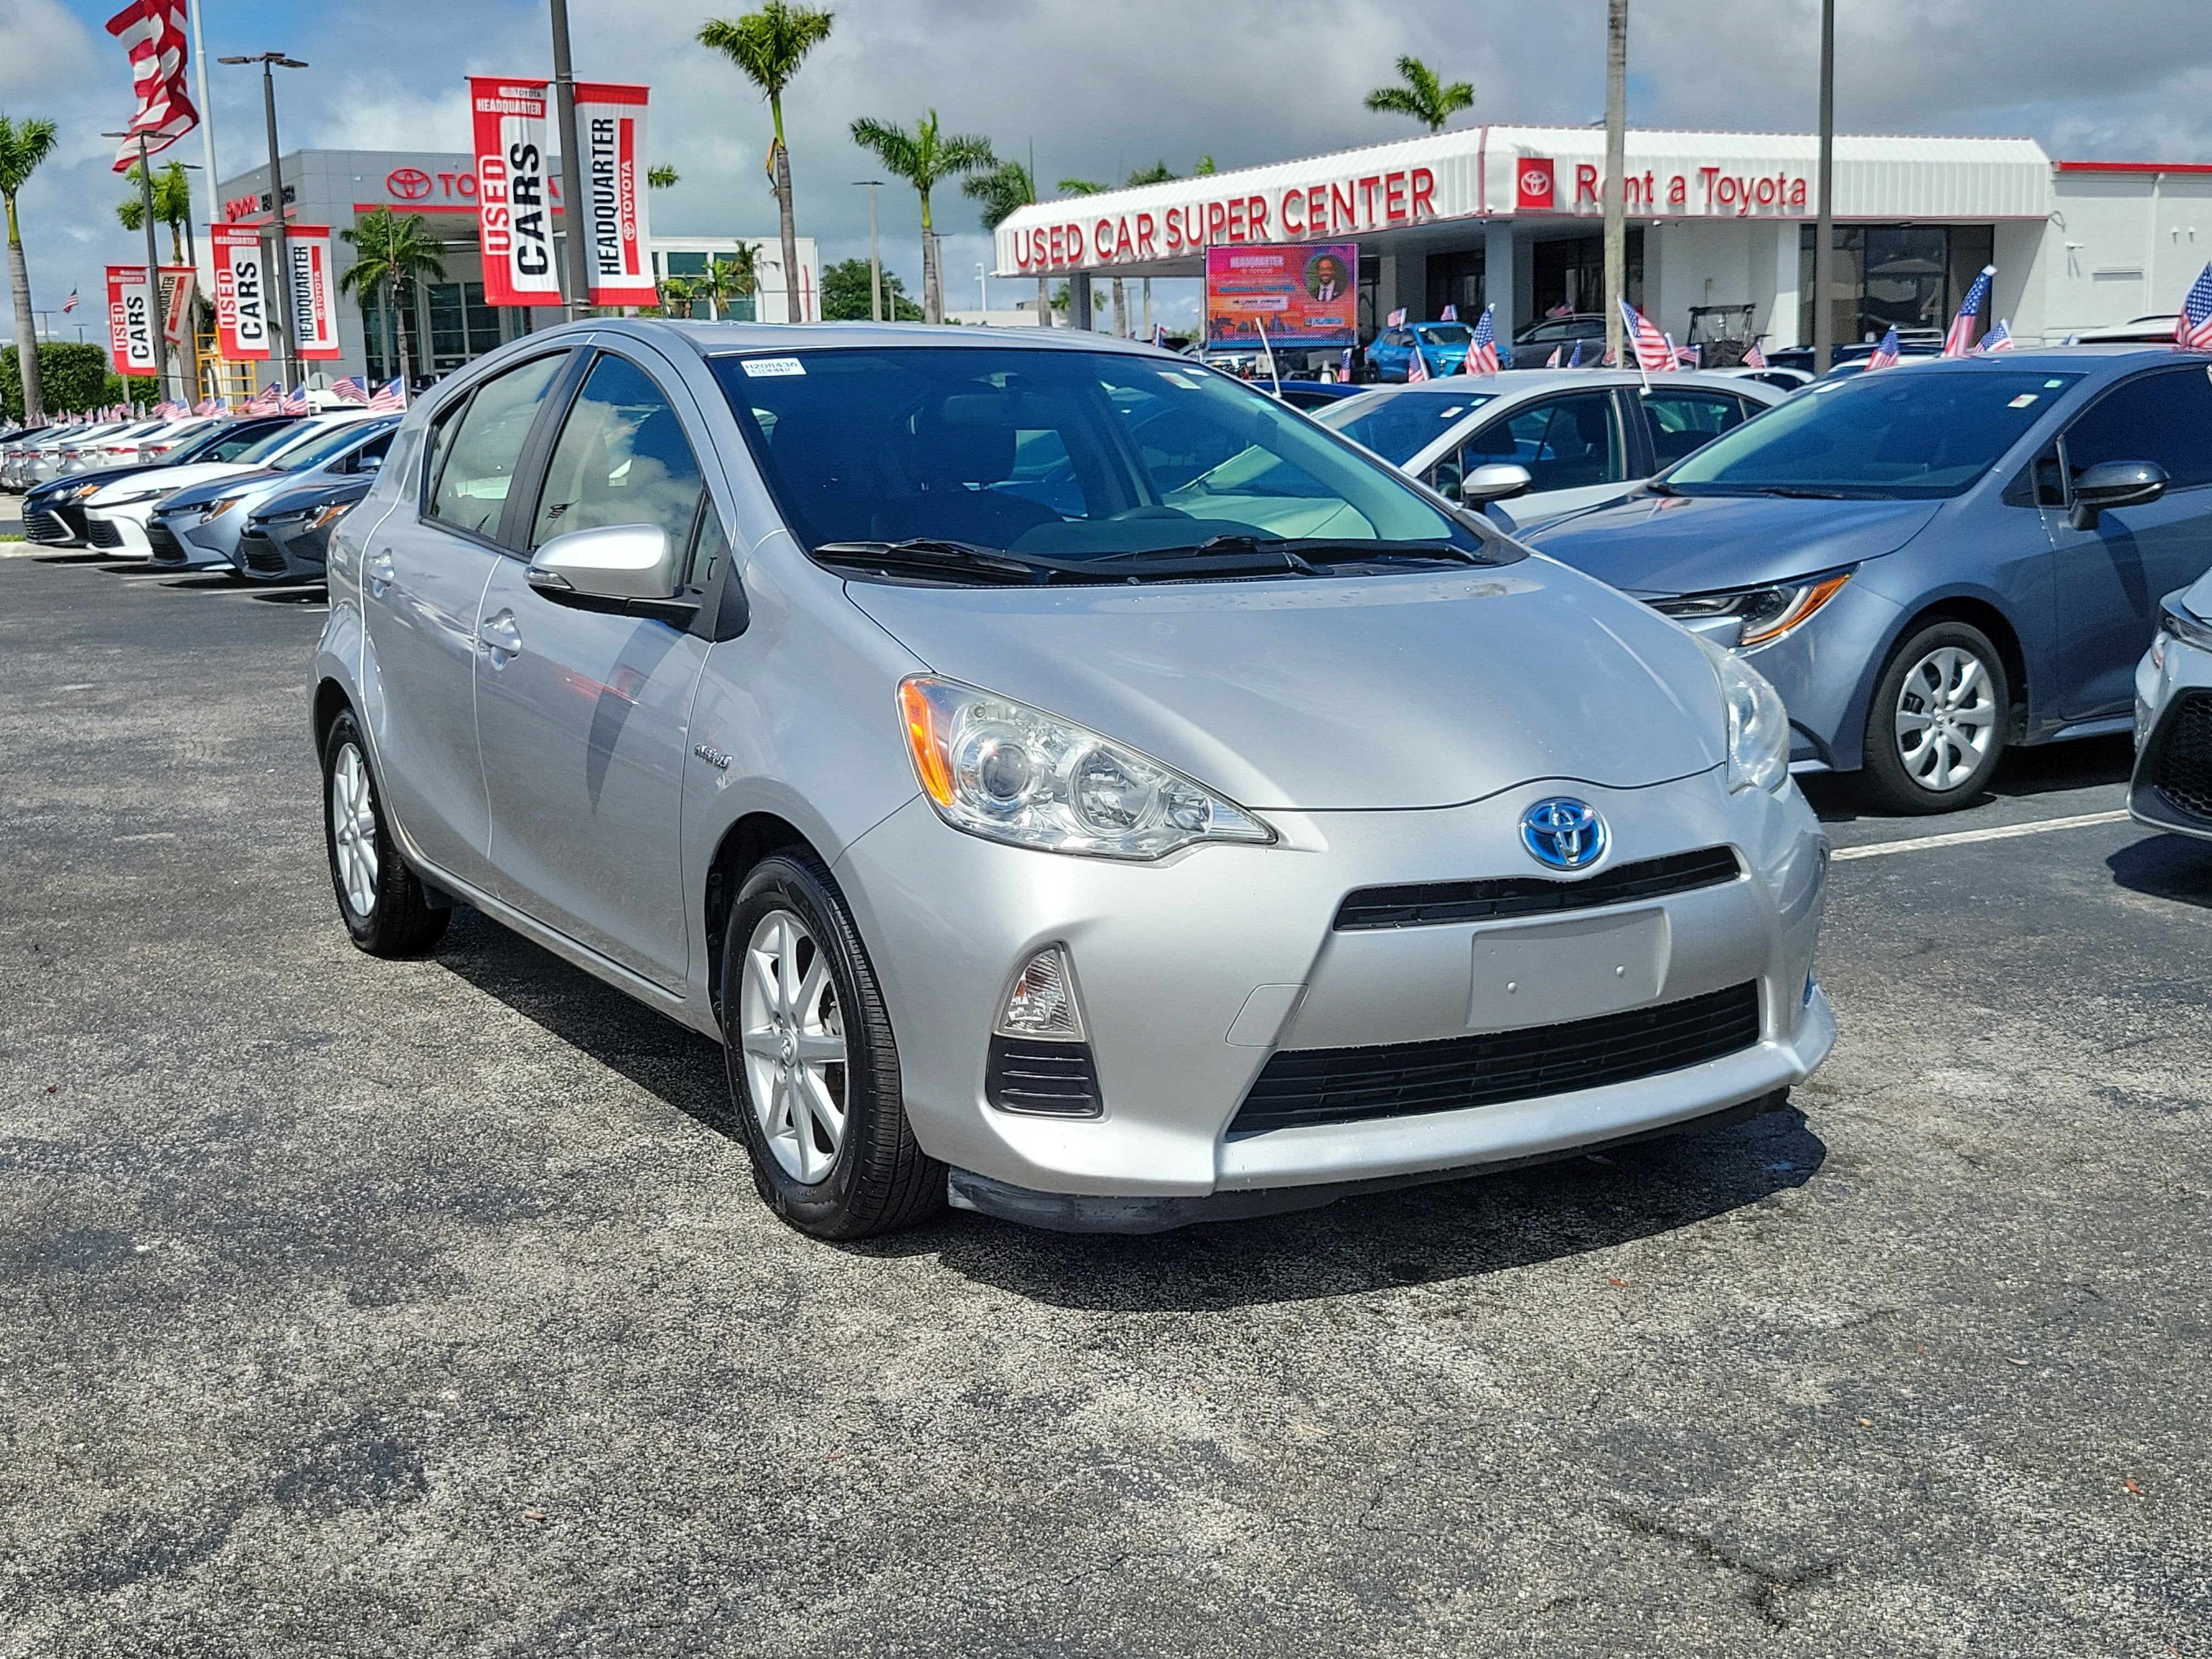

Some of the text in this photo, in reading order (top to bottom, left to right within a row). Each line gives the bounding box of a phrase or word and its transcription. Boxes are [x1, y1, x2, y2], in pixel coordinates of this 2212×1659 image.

[476, 97, 541, 116] HEADQUARTER
[515, 89, 541, 97] TOYOTA
[483, 161, 509, 251] USED
[510, 143, 549, 275] CARS
[591, 119, 622, 275] HEADQUARTER
[621, 161, 633, 221] TOYOTA
[1015, 167, 1435, 268] USED CAR SUPER CENTER
[1576, 163, 1805, 216] Rnt a Toyota
[219, 271, 236, 326] USED
[236, 262, 262, 339] CARS
[294, 246, 315, 341] HEADQUARTER
[313, 271, 325, 308] TOYOTA
[112, 304, 128, 348] USED
[127, 296, 149, 359] CARS
